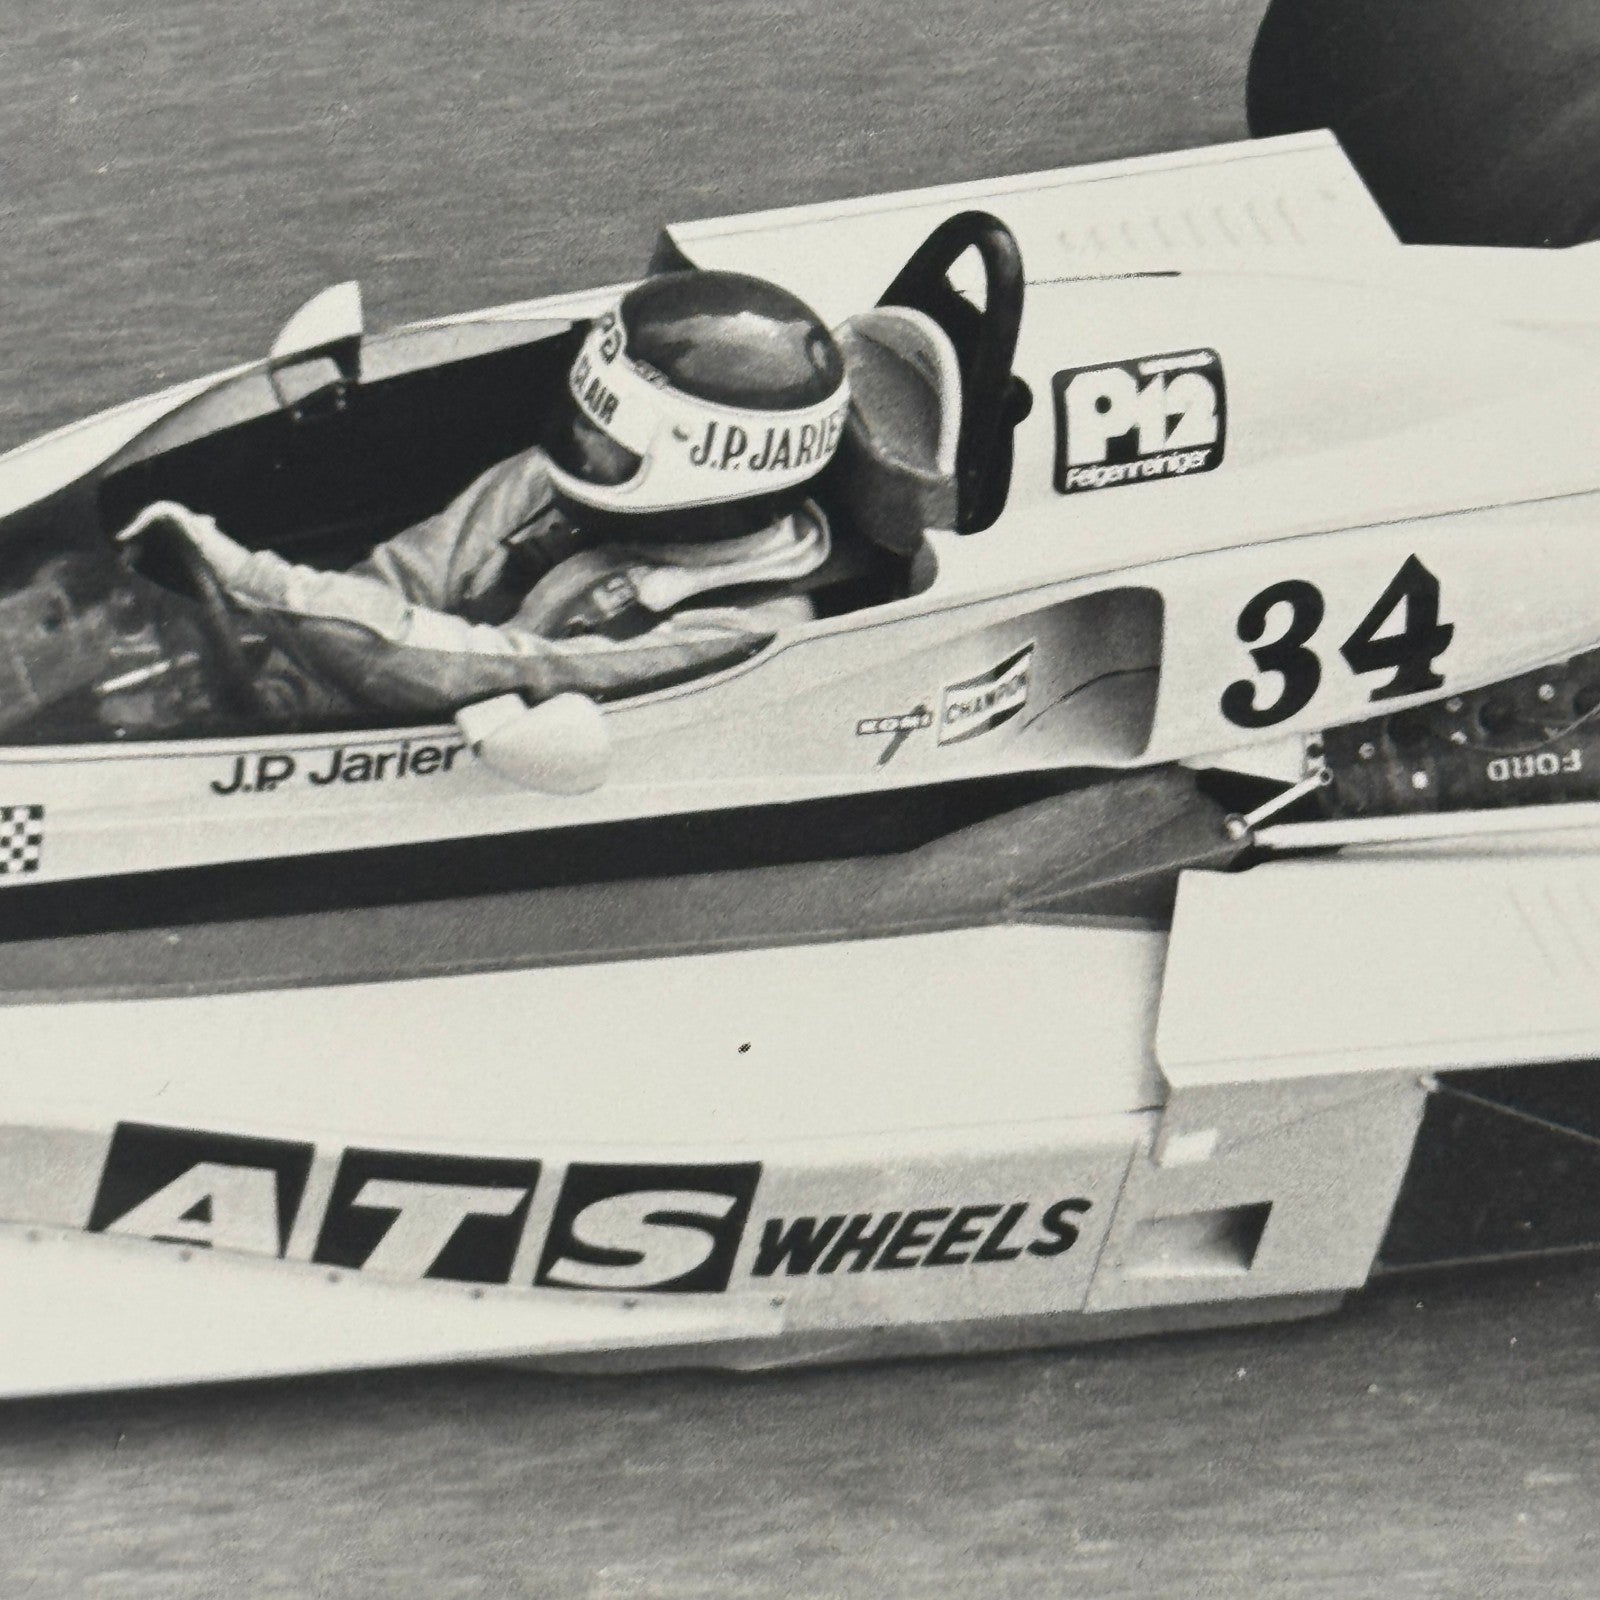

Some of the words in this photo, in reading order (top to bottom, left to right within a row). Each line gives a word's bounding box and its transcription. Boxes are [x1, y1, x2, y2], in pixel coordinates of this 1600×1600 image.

[1220, 552, 1455, 729] 34
[308, 739, 466, 786] Jarier
[1486, 748, 1583, 783] FORD
[106, 1160, 739, 1288] ATS
[751, 1198, 1093, 1277] WHEELS
